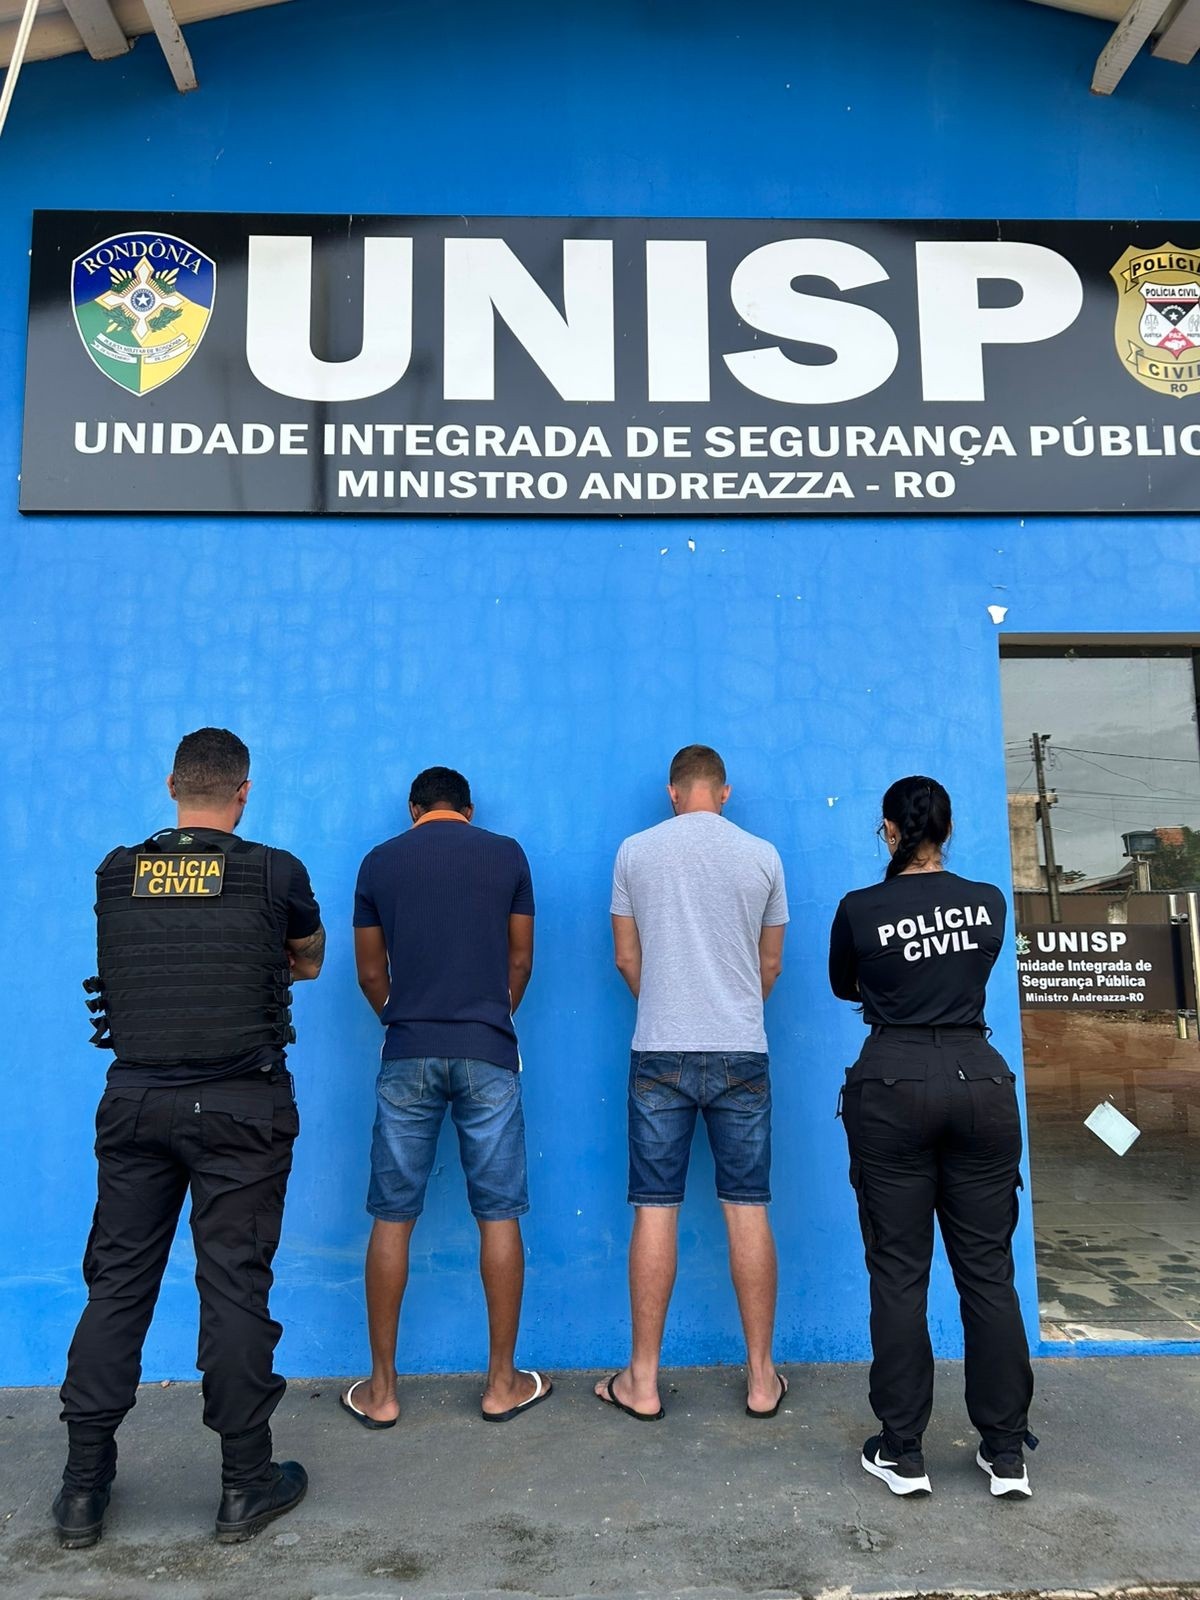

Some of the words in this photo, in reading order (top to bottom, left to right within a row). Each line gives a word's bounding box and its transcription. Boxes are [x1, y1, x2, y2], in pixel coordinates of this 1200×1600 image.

[81, 238, 203, 275] RONDÔNIA
[1145, 287, 1176, 297] POLÍCIA
[1178, 288, 1198, 297] CIVIL
[245, 235, 1084, 405] UNISP
[1170, 383, 1188, 393] RO
[74, 421, 309, 456] UNIDADE
[323, 423, 613, 458] INTEGRADA
[627, 425, 692, 458] DE
[703, 424, 1018, 467] SEGURANÇA
[338, 469, 568, 501] MINISTRO
[578, 470, 856, 500] ANDREAZZA
[894, 470, 956, 500] RO
[138, 856, 221, 878] POLÍCIA
[148, 876, 210, 894] CIVIL
[877, 905, 992, 947] POLÍCIA
[903, 930, 979, 962] CIVIL
[1036, 931, 1127, 953] UNISP
[1068, 959, 1132, 974] Integrada
[1135, 959, 1153, 972] de
[1022, 974, 1094, 990] Segurança
[1096, 973, 1146, 988] Pública
[1025, 991, 1069, 1002] Ministro
[1071, 991, 1145, 1002] Andreazza-RO
